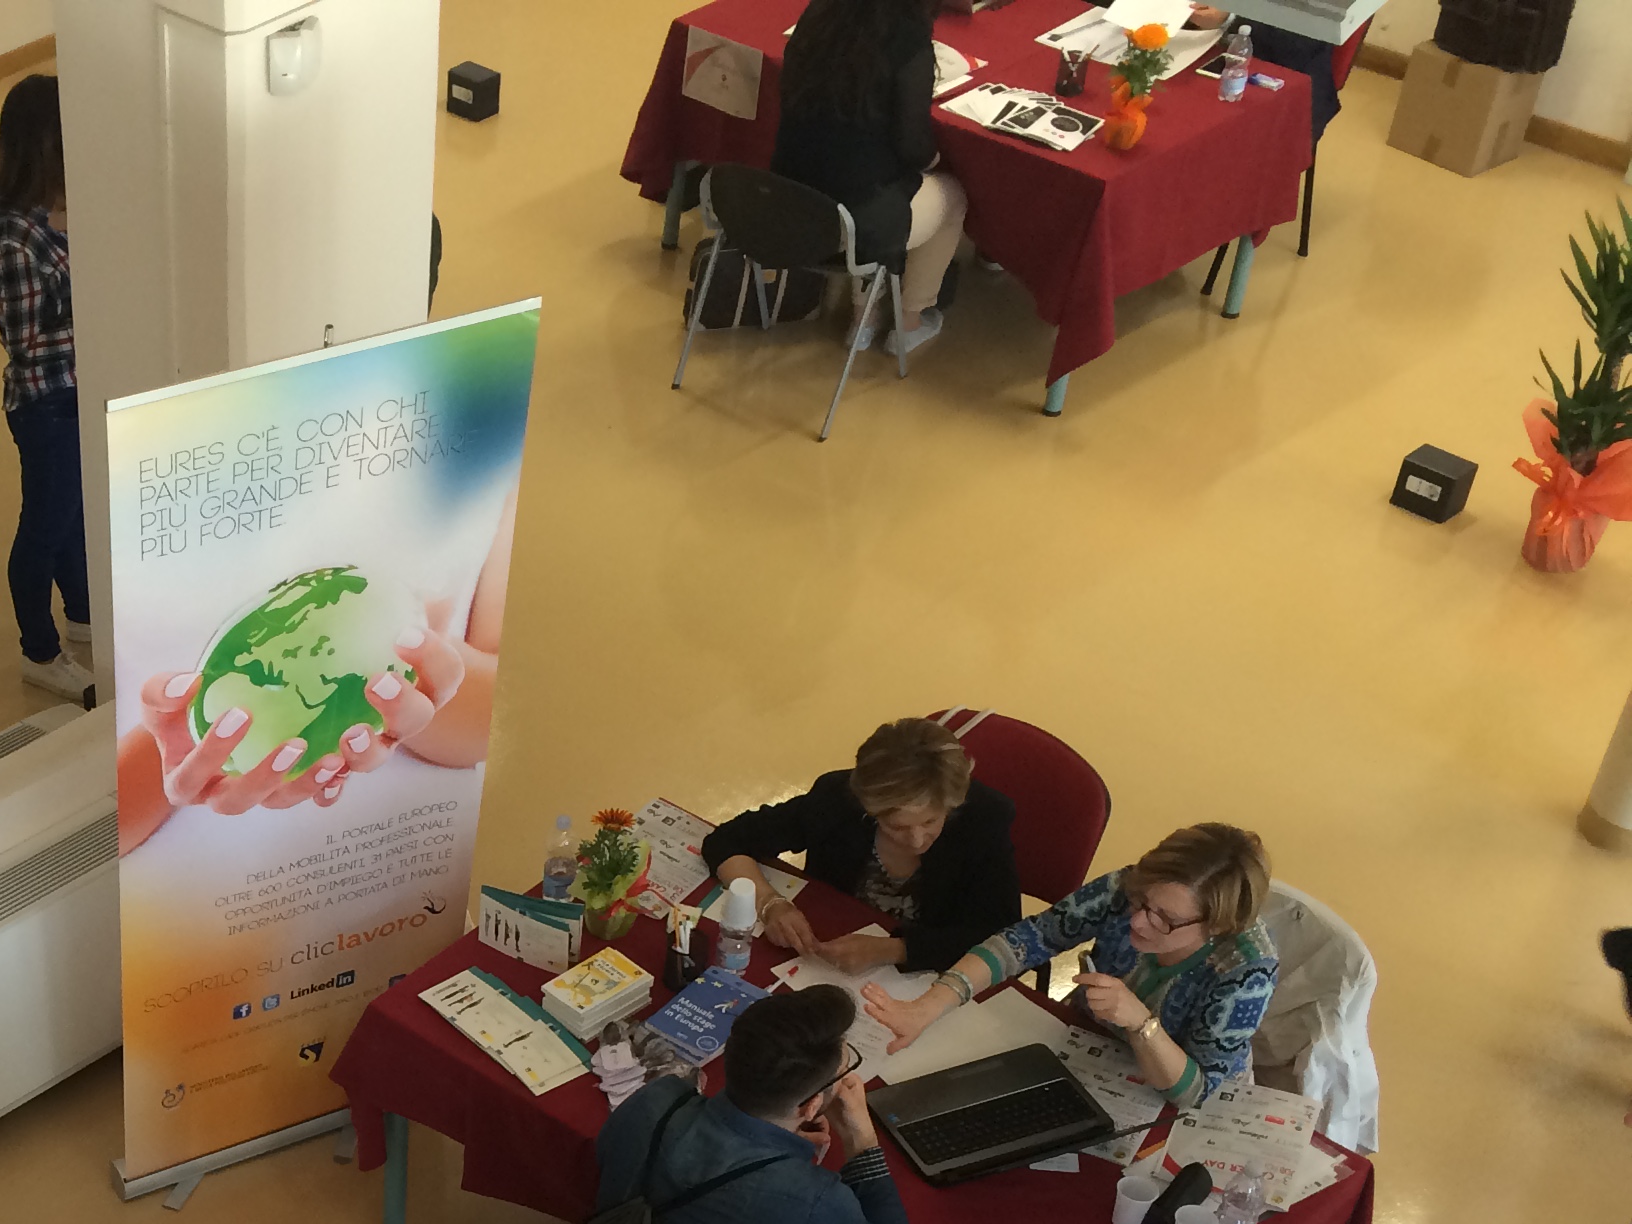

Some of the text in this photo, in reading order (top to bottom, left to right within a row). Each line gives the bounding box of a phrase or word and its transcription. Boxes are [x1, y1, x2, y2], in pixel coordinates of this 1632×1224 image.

[139, 441, 225, 483] EURES
[296, 406, 364, 442] CON
[376, 390, 431, 422] CHI
[139, 414, 442, 510] PARTE PER DIVENTARE
[140, 502, 187, 536] PIÙ
[199, 470, 314, 520] GRANDE
[325, 464, 341, 488] E
[140, 528, 187, 562] PIÙ
[342, 817, 395, 840] PORTALE
[398, 800, 459, 824] EUROPEO
[423, 833, 456, 850] CON
[247, 865, 285, 885] DELLA
[289, 912, 429, 966] cliclavoro
[670, 1003, 717, 1031] dello stage
[674, 1012, 705, 1032] Europa
[678, 996, 716, 1020] Manuale
